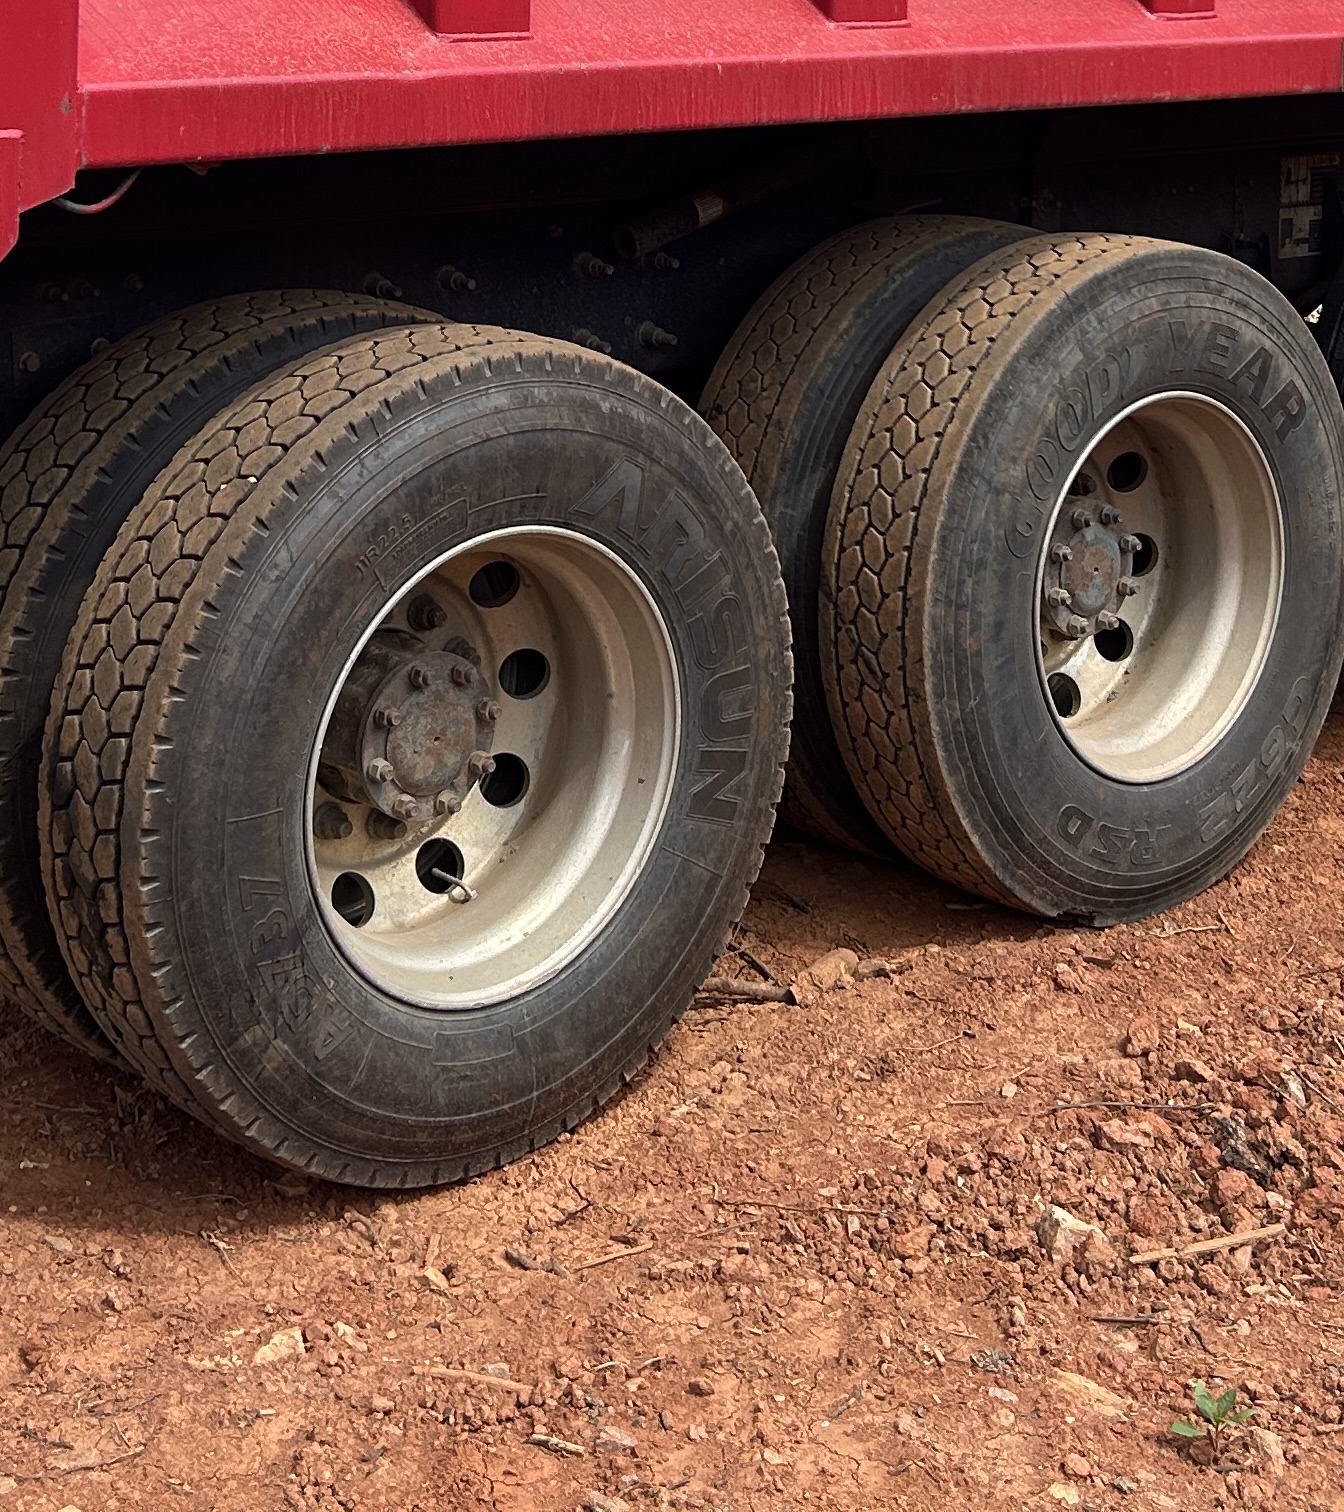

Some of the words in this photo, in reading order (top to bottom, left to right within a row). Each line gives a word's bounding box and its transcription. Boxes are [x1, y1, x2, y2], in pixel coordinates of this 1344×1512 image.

[1004, 316, 1308, 558] GOODYEAR
[568, 455, 754, 828] ARISUN
[1055, 803, 1172, 866] RSD
[1198, 675, 1312, 843] G622
